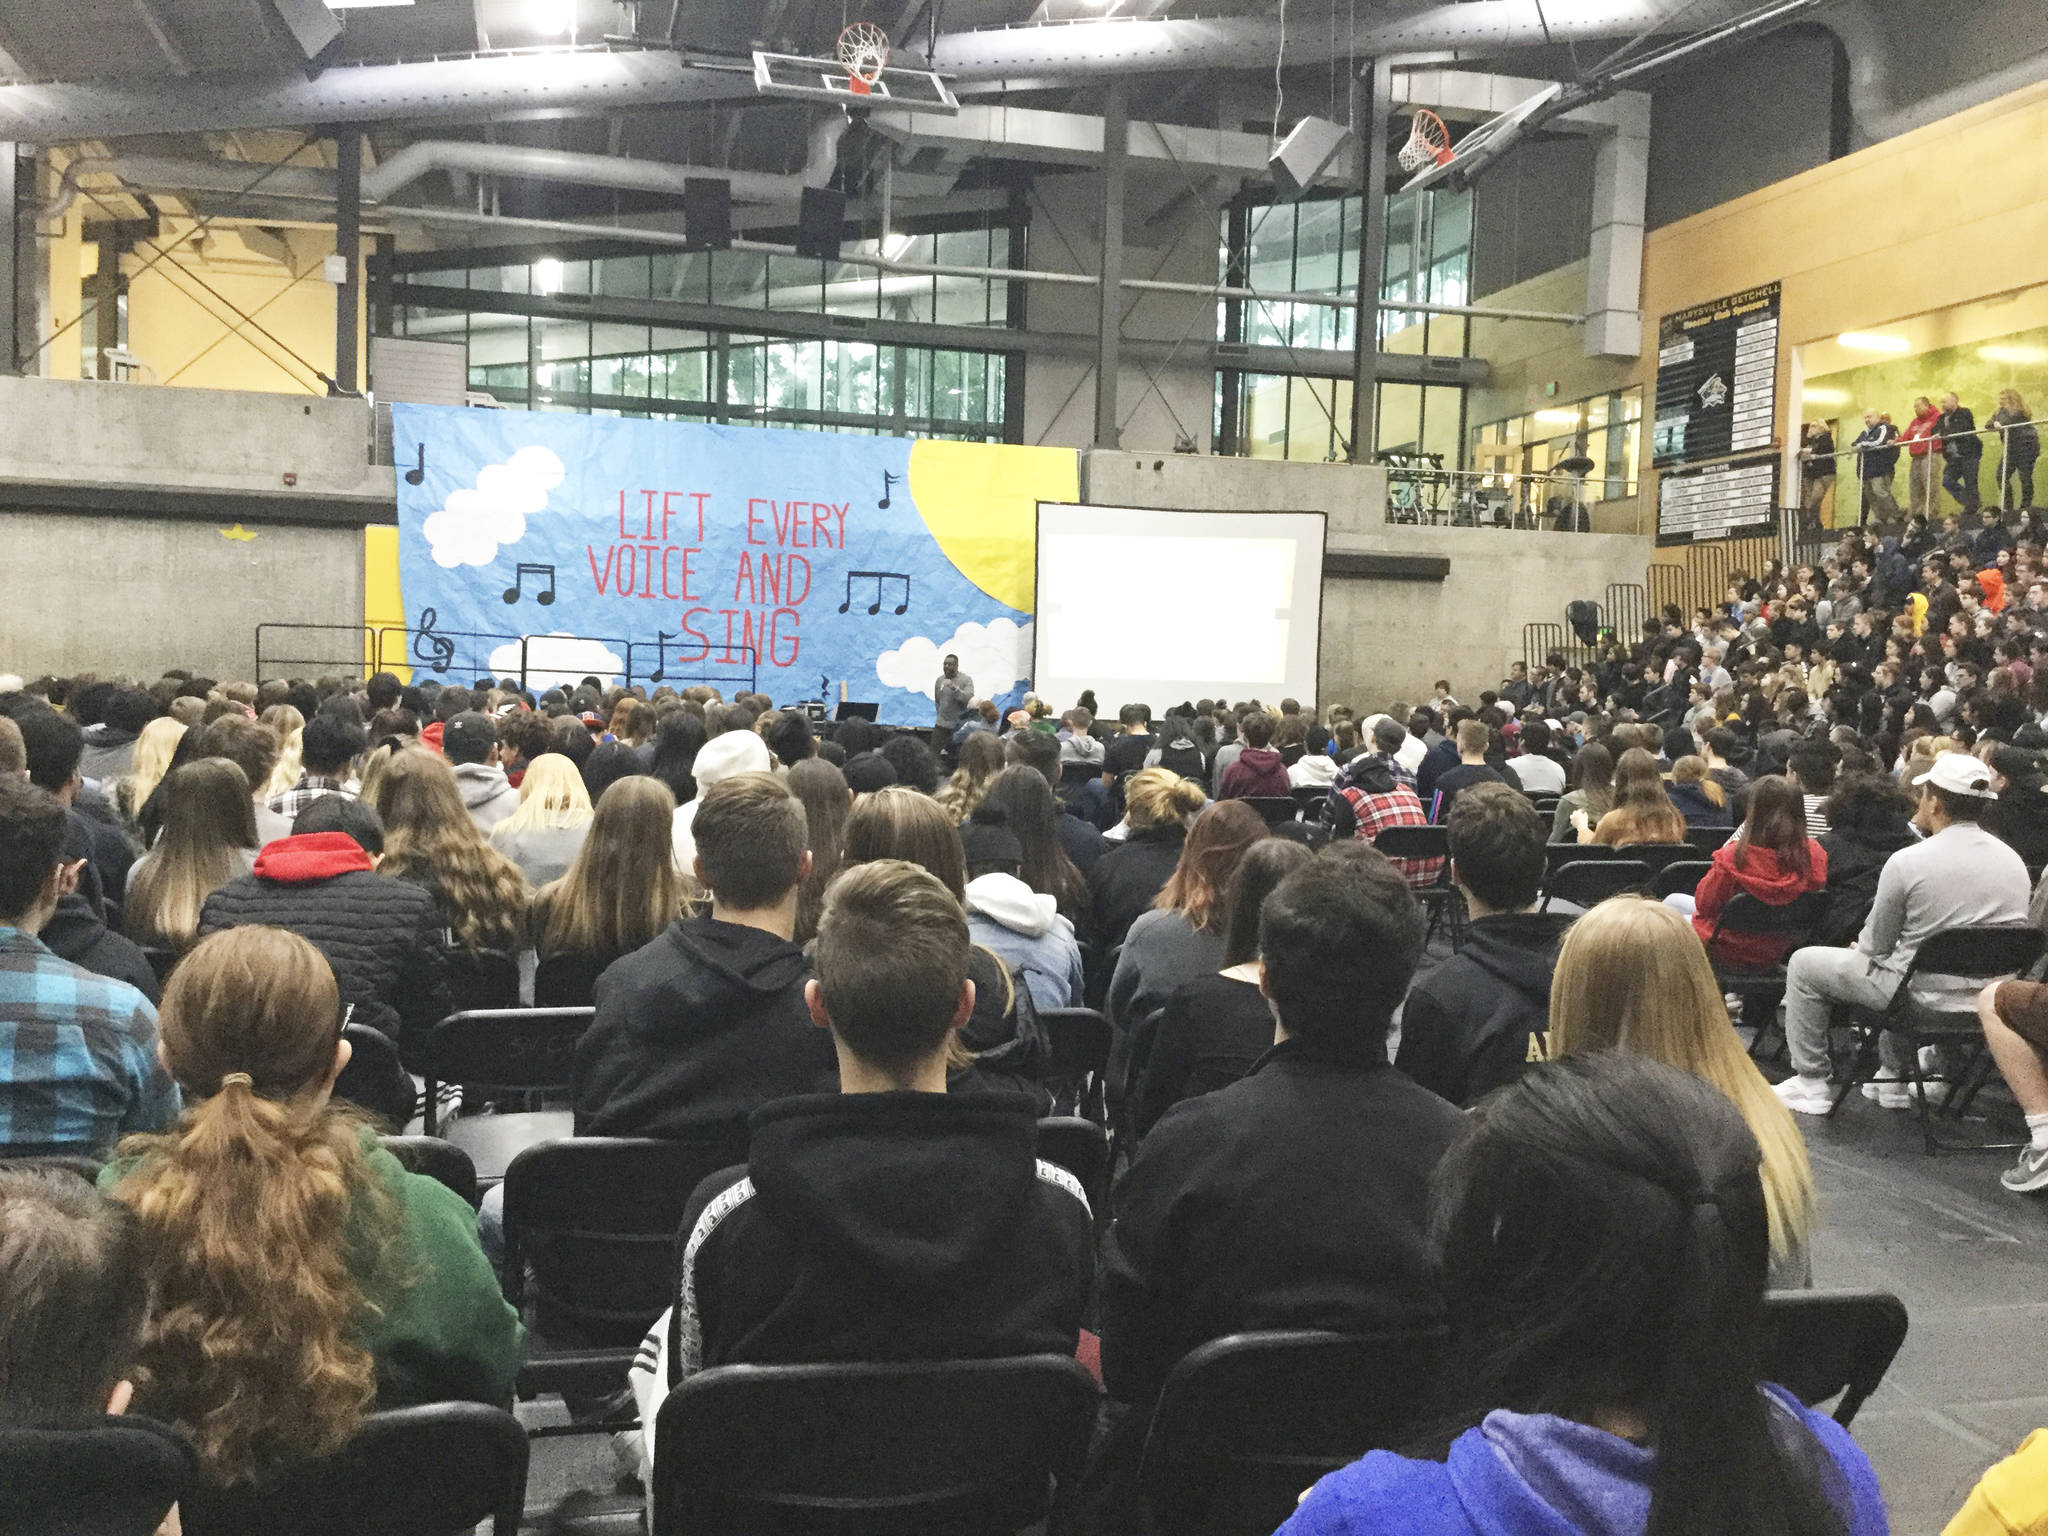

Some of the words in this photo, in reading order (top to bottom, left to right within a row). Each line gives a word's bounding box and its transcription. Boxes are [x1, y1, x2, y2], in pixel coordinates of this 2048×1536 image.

[1675, 298, 1728, 321] MARYSVILLE
[1731, 283, 1780, 306] GETCHELL
[619, 489, 711, 542] LIFT
[747, 498, 850, 550] EVERY
[587, 544, 702, 601] VOICE
[734, 551, 811, 606] AND
[678, 607, 800, 668] SING
